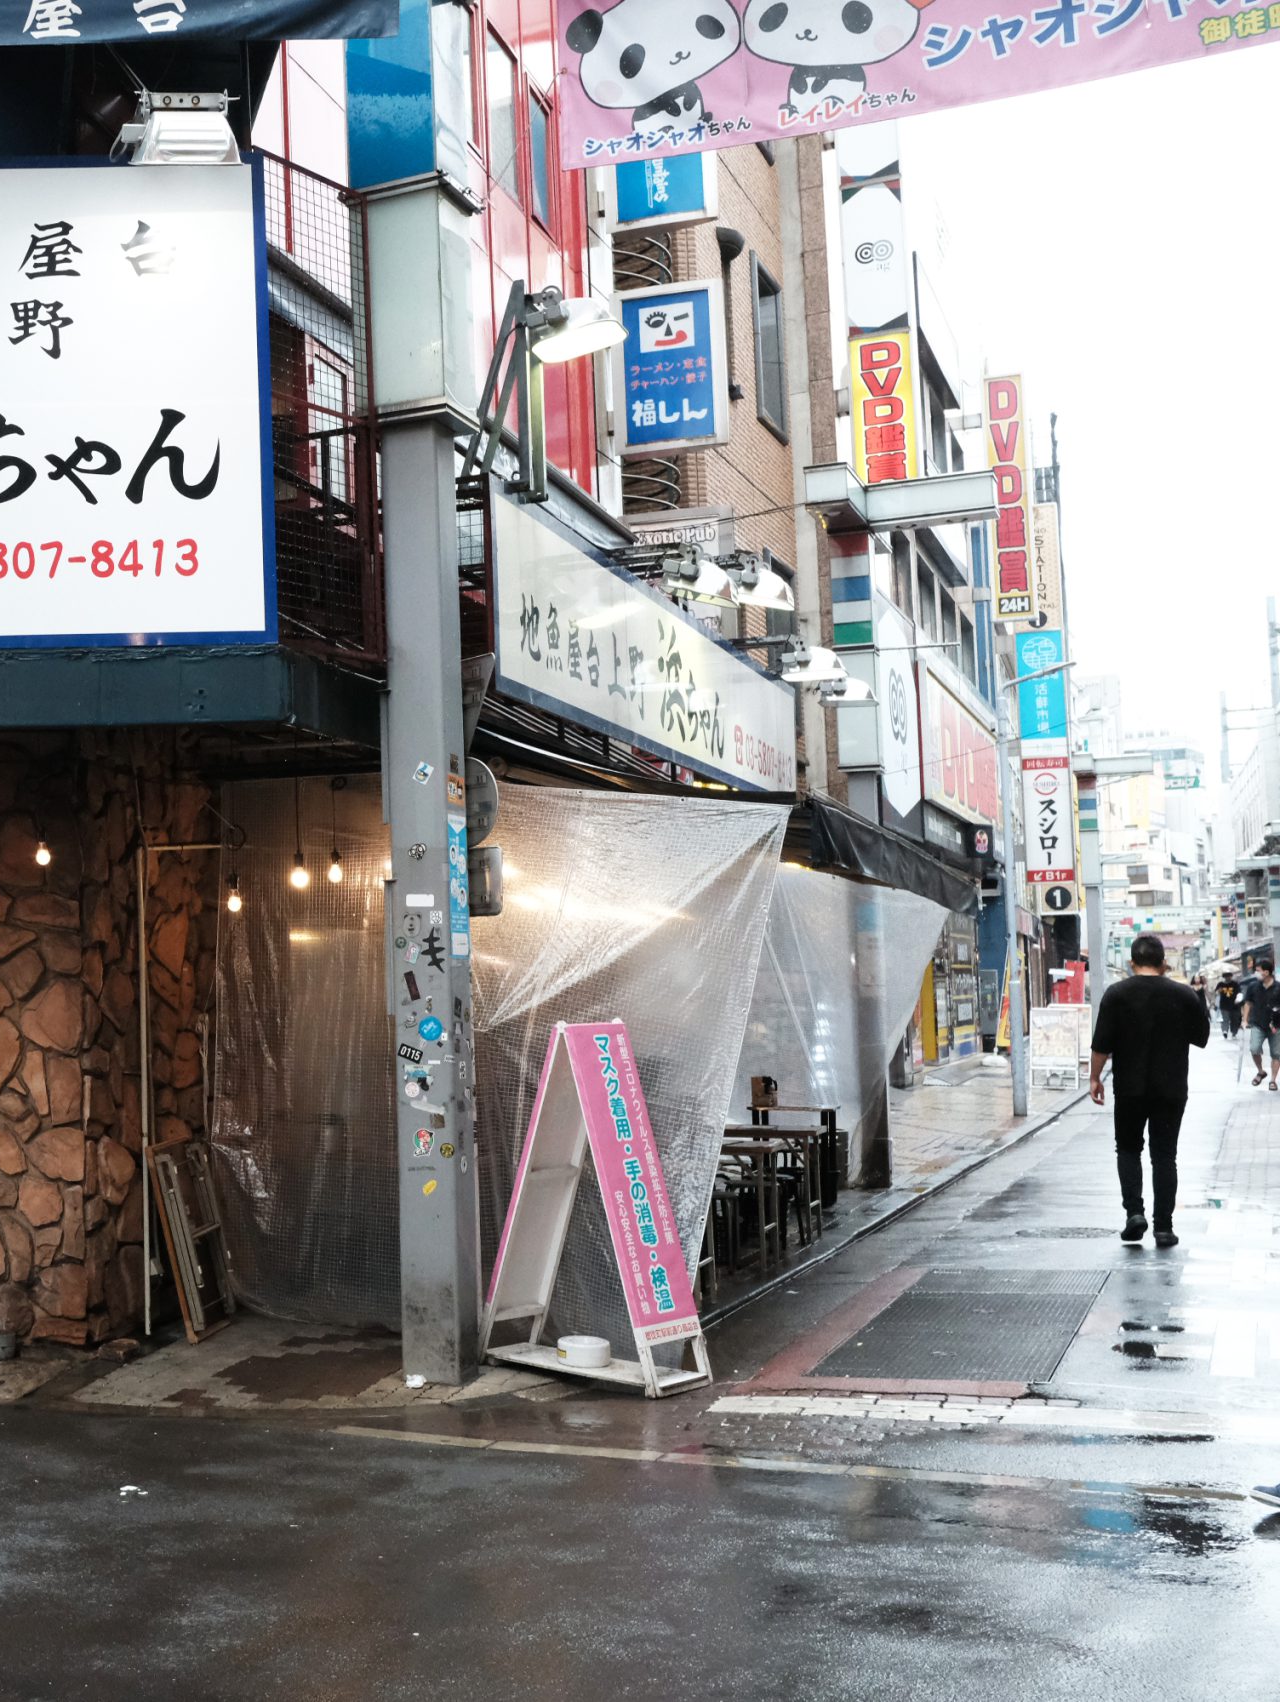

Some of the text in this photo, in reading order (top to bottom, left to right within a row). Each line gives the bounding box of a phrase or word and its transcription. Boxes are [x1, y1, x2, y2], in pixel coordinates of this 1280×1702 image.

[779, 88, 916, 127] レイレイちゃん
[584, 112, 751, 156] シャオシャオちゃん
[631, 398, 708, 427] 福しん
[859, 341, 907, 484] DVD鑑賞
[988, 380, 1028, 593] DVD鑑賞
[686, 525, 715, 543] Pub
[1000, 597, 1030, 613] 24H
[657, 618, 725, 760] 浜ちゃん
[1037, 798, 1059, 866] スシロー
[1045, 871, 1067, 881] B1F
[400, 1045, 421, 1062] 0115
